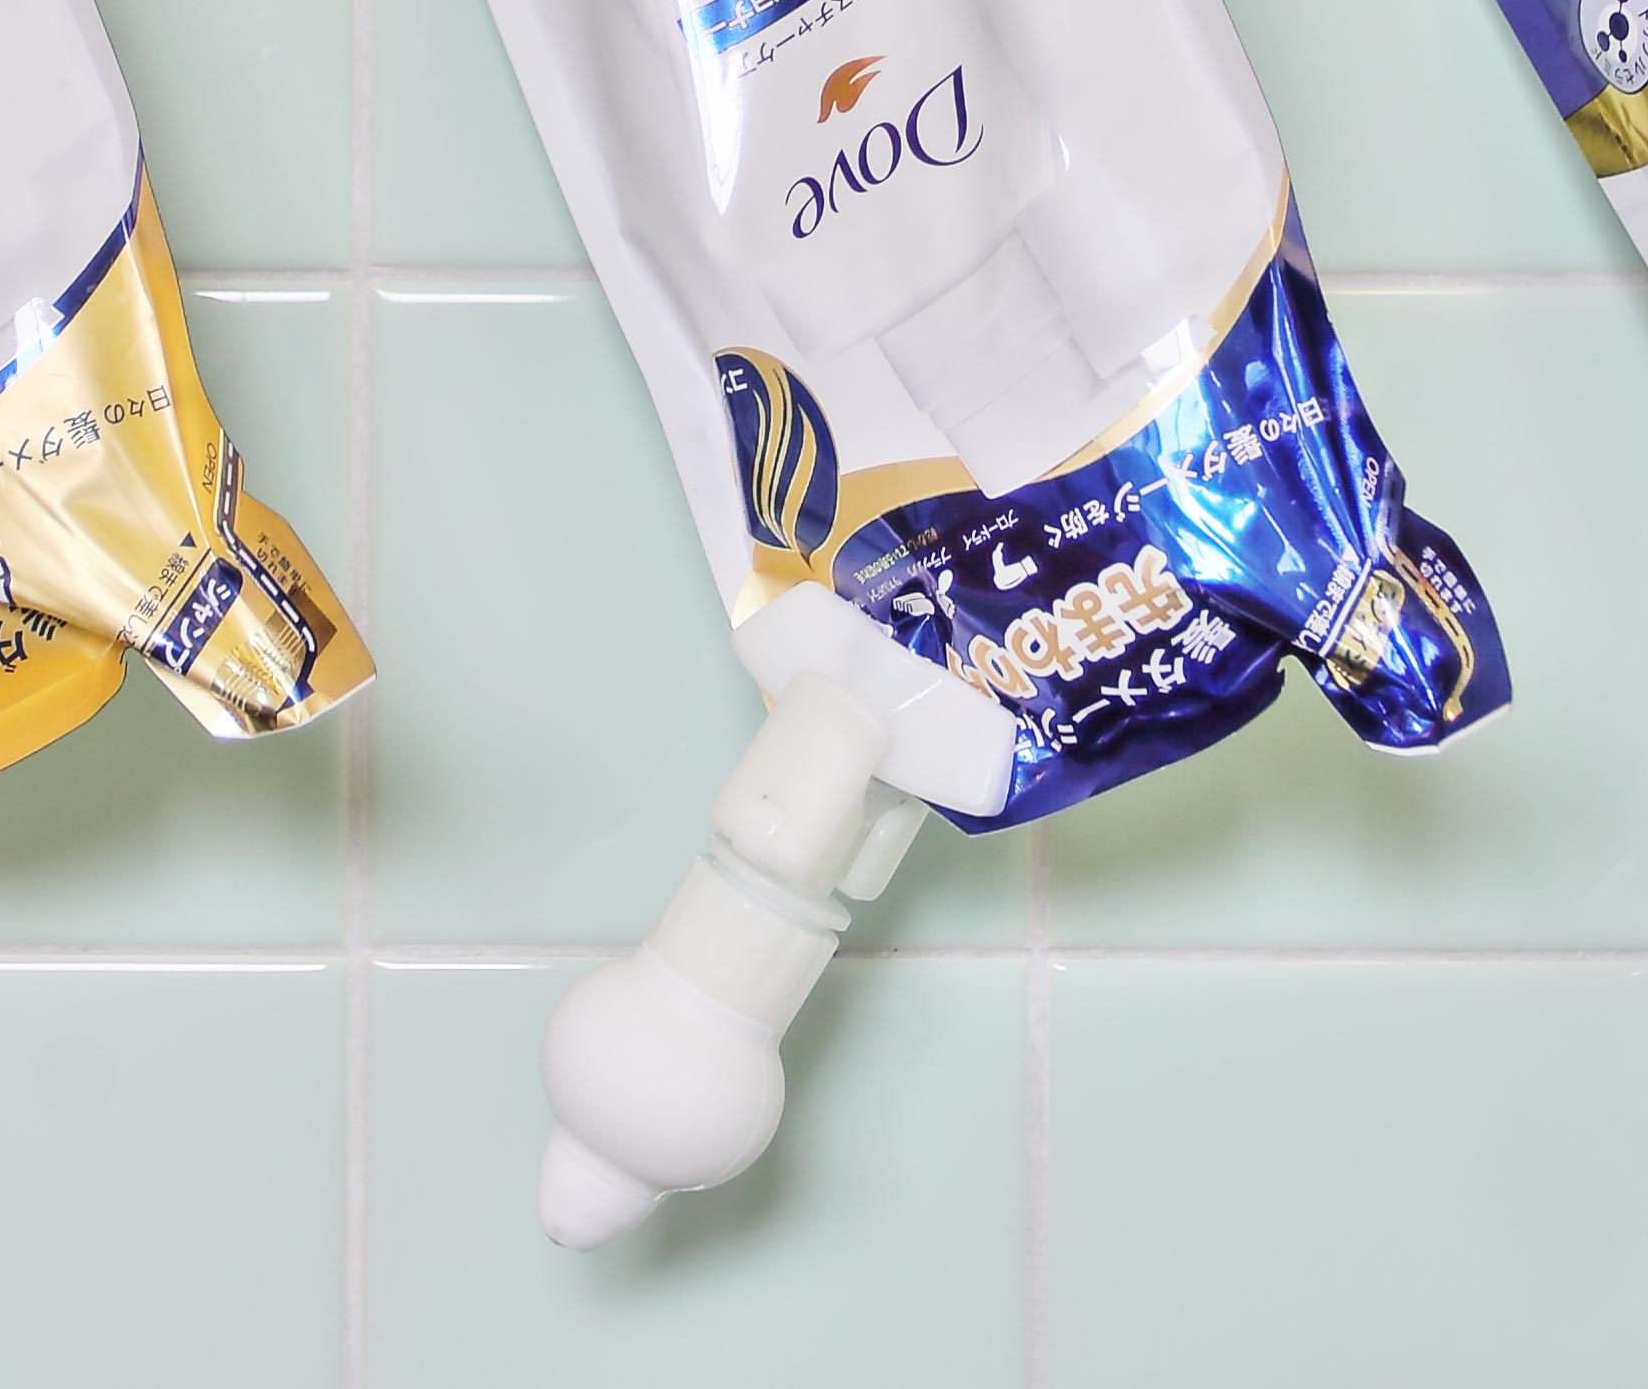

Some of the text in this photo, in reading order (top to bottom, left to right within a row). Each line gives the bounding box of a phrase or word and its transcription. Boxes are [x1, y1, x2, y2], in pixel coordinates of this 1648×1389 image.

[784, 64, 985, 239] Dove
[202, 442, 218, 495] OPEN
[1359, 456, 1380, 509] OPEN
